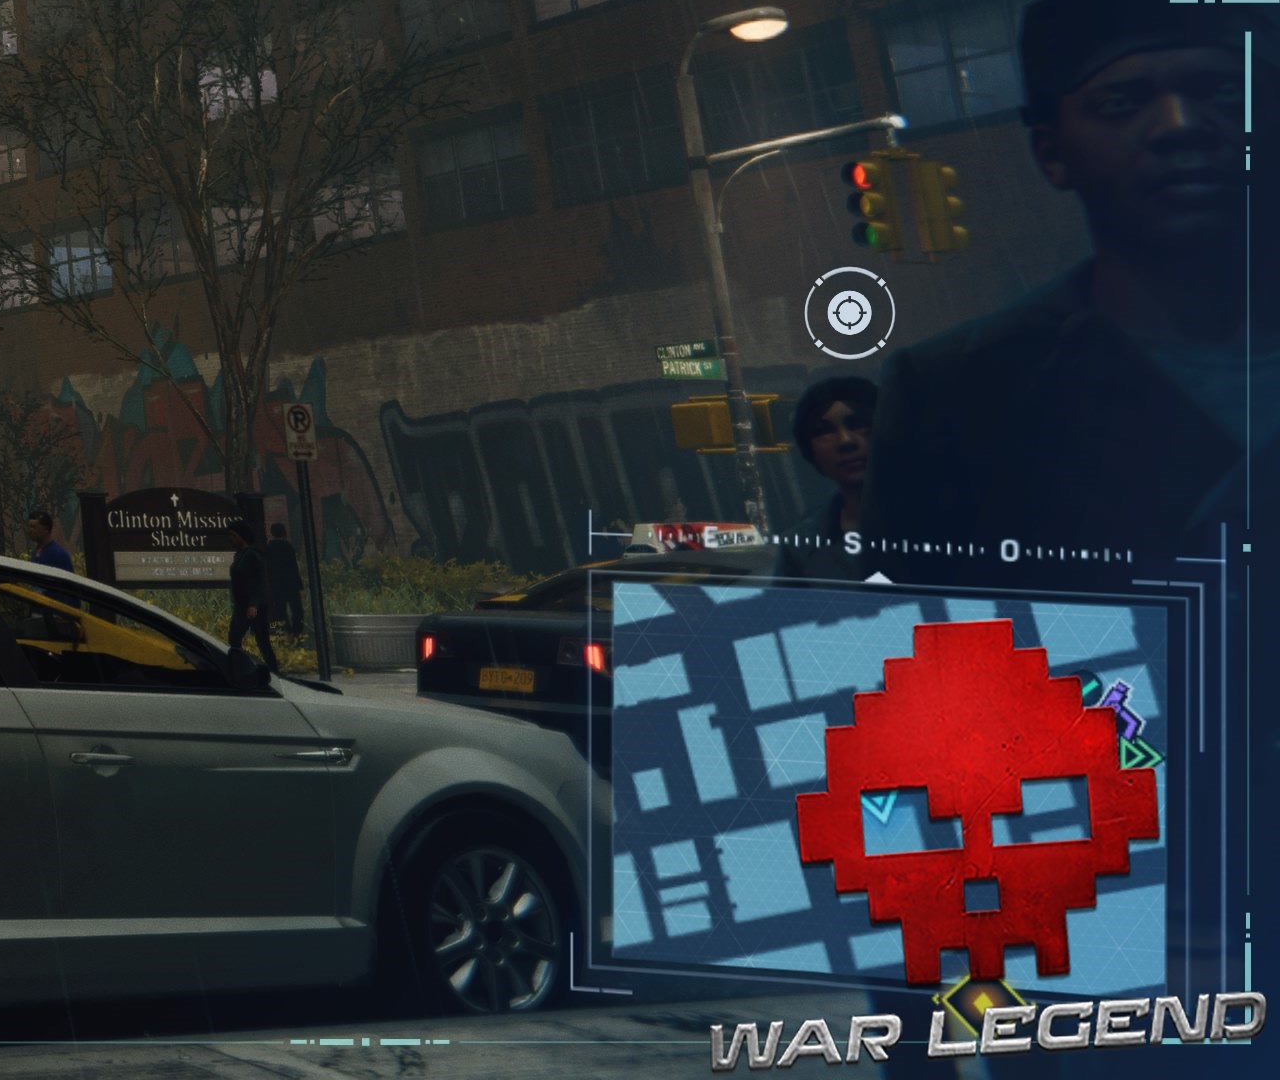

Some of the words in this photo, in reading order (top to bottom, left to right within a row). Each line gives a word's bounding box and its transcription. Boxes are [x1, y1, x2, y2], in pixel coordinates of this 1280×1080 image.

[656, 344, 692, 359] CLINTON
[662, 360, 703, 376] PATRICK
[107, 509, 172, 529] Clinton
[151, 530, 207, 547] Shelter
